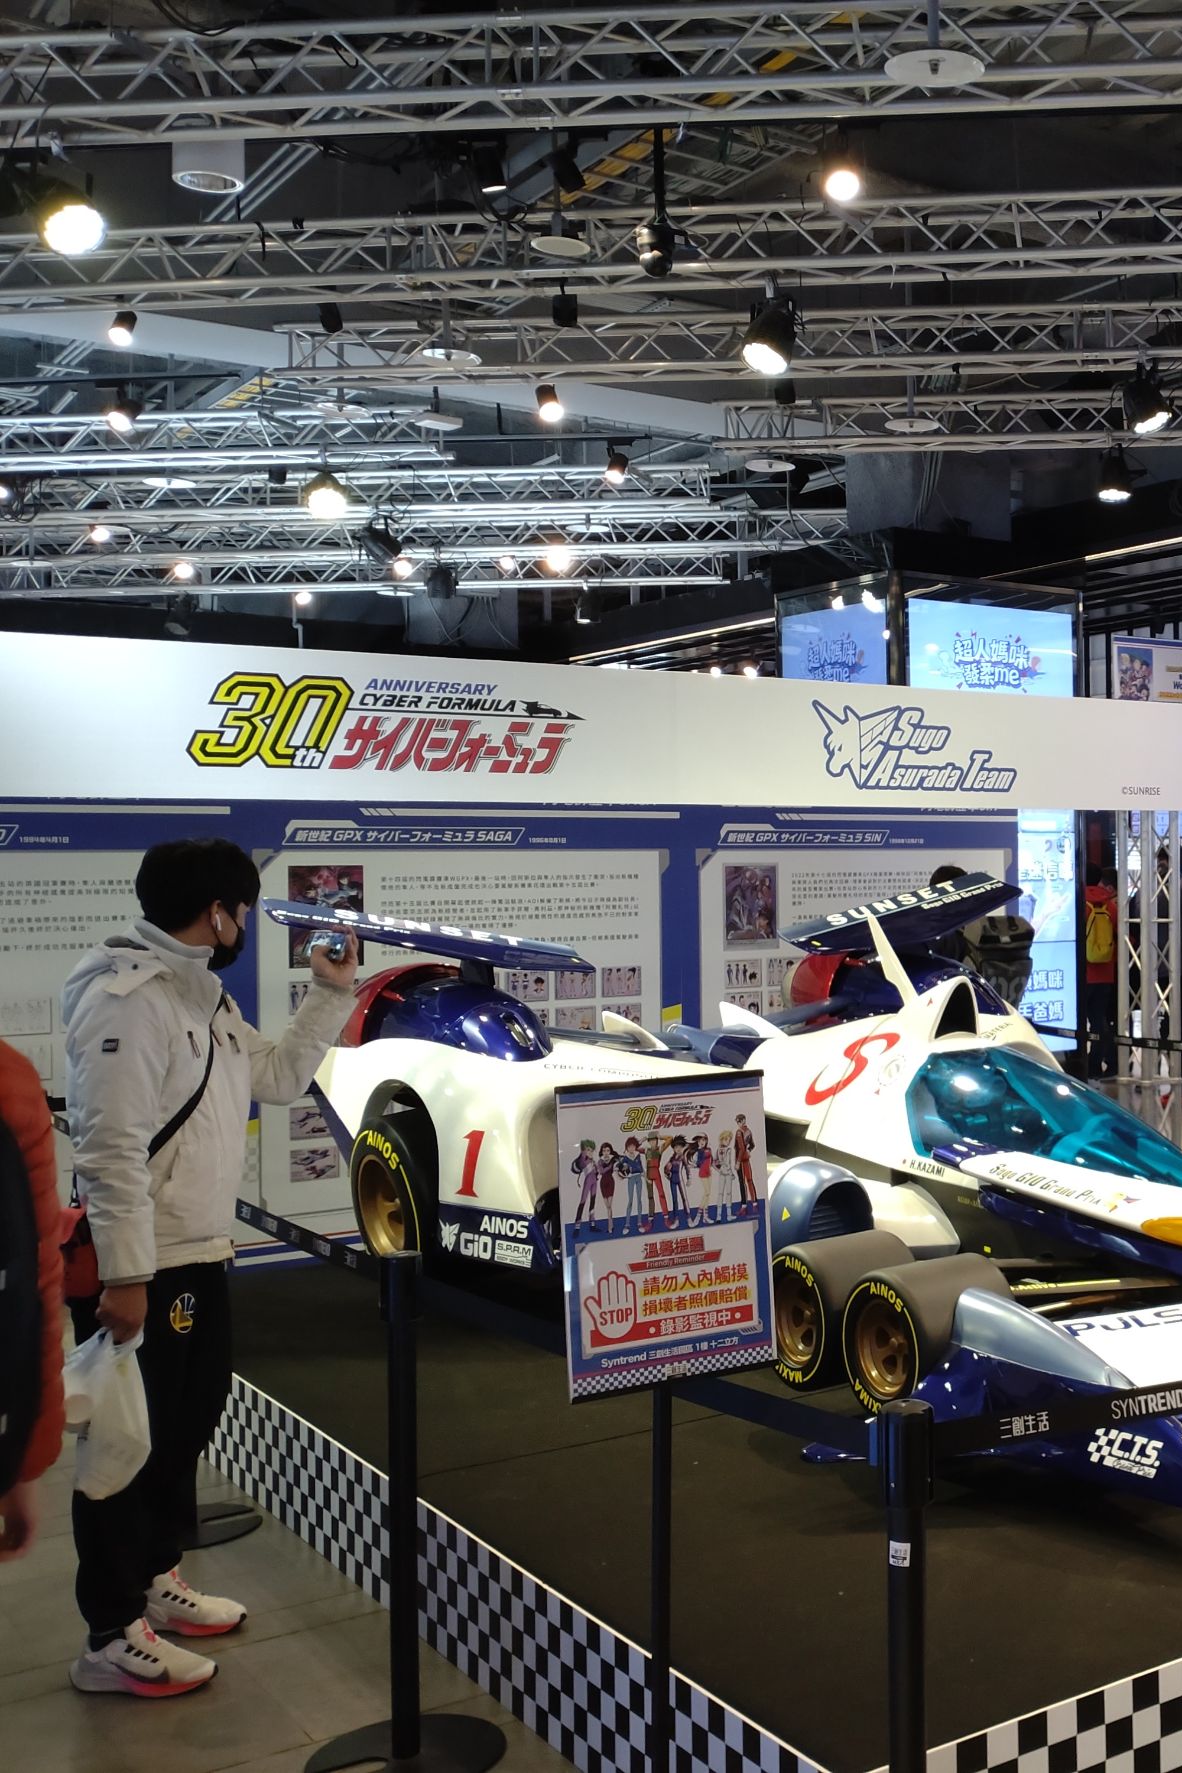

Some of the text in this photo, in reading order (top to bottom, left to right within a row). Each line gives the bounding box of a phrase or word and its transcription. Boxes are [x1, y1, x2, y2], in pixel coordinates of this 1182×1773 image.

[953, 637, 1031, 669] 超人媽咪
[359, 693, 516, 713] CYBER FORMULA
[364, 678, 499, 697] ANNIVERSARY
[891, 710, 950, 753] Sugo
[870, 751, 1016, 791] Asurada Team
[294, 830, 332, 842] 新世紀
[333, 830, 363, 842] GPX
[475, 831, 513, 842] SAGA
[756, 833, 779, 842] GPX
[864, 833, 882, 842] SIN
[827, 879, 957, 926] SUNSET
[333, 908, 524, 946] SUNSET
[804, 1032, 901, 1106] S
[366, 1129, 400, 1170] AINOS
[455, 1129, 485, 1198] 1
[909, 1158, 946, 1178] H.KAZAMI
[480, 1214, 529, 1239] AINOS
[646, 1254, 706, 1269] Friendly Reminder
[785, 1255, 815, 1287] AINOS
[642, 1262, 749, 1296] 請勿入內觸摸
[642, 1285, 748, 1317] 損壞者照價賠償
[869, 1281, 904, 1313] AINOS
[600, 1307, 633, 1326] STOP
[660, 1310, 731, 1335] 錄影監視中
[601, 1352, 647, 1368] Syntrend
[710, 1335, 739, 1350] 十二立方
[999, 1411, 1050, 1439] 三創生活
[1110, 1431, 1161, 1467] C.T.S.
